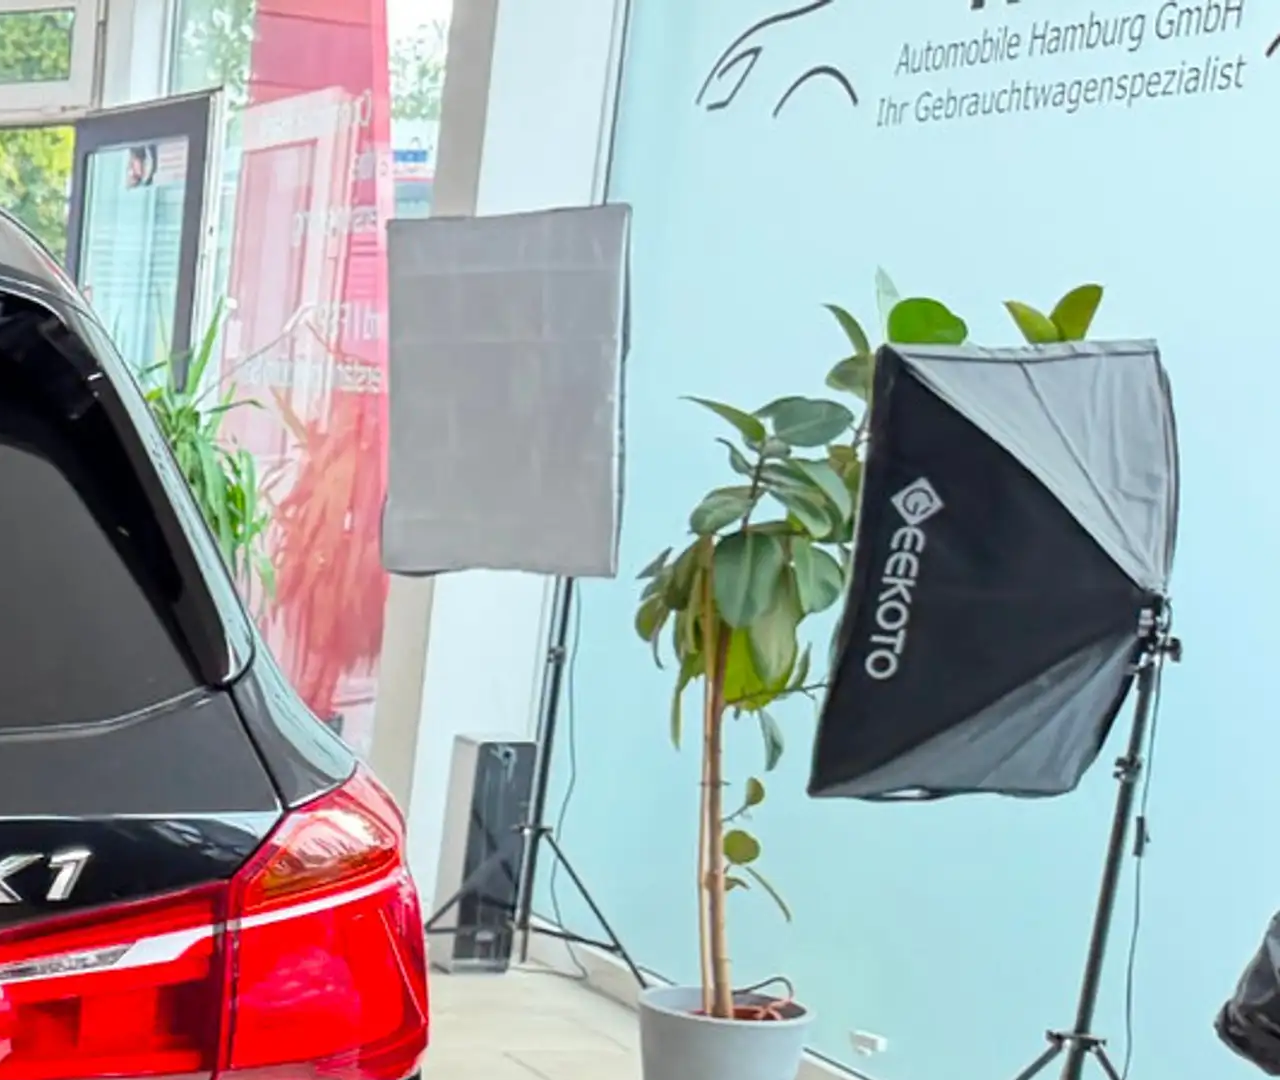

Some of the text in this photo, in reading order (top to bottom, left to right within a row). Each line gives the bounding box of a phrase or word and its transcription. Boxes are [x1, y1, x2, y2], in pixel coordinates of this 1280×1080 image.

[895, 0, 1244, 77] Automobile Hamburg GmbH
[876, 53, 1248, 128] Ihr Gebrauchtwagenspezialist
